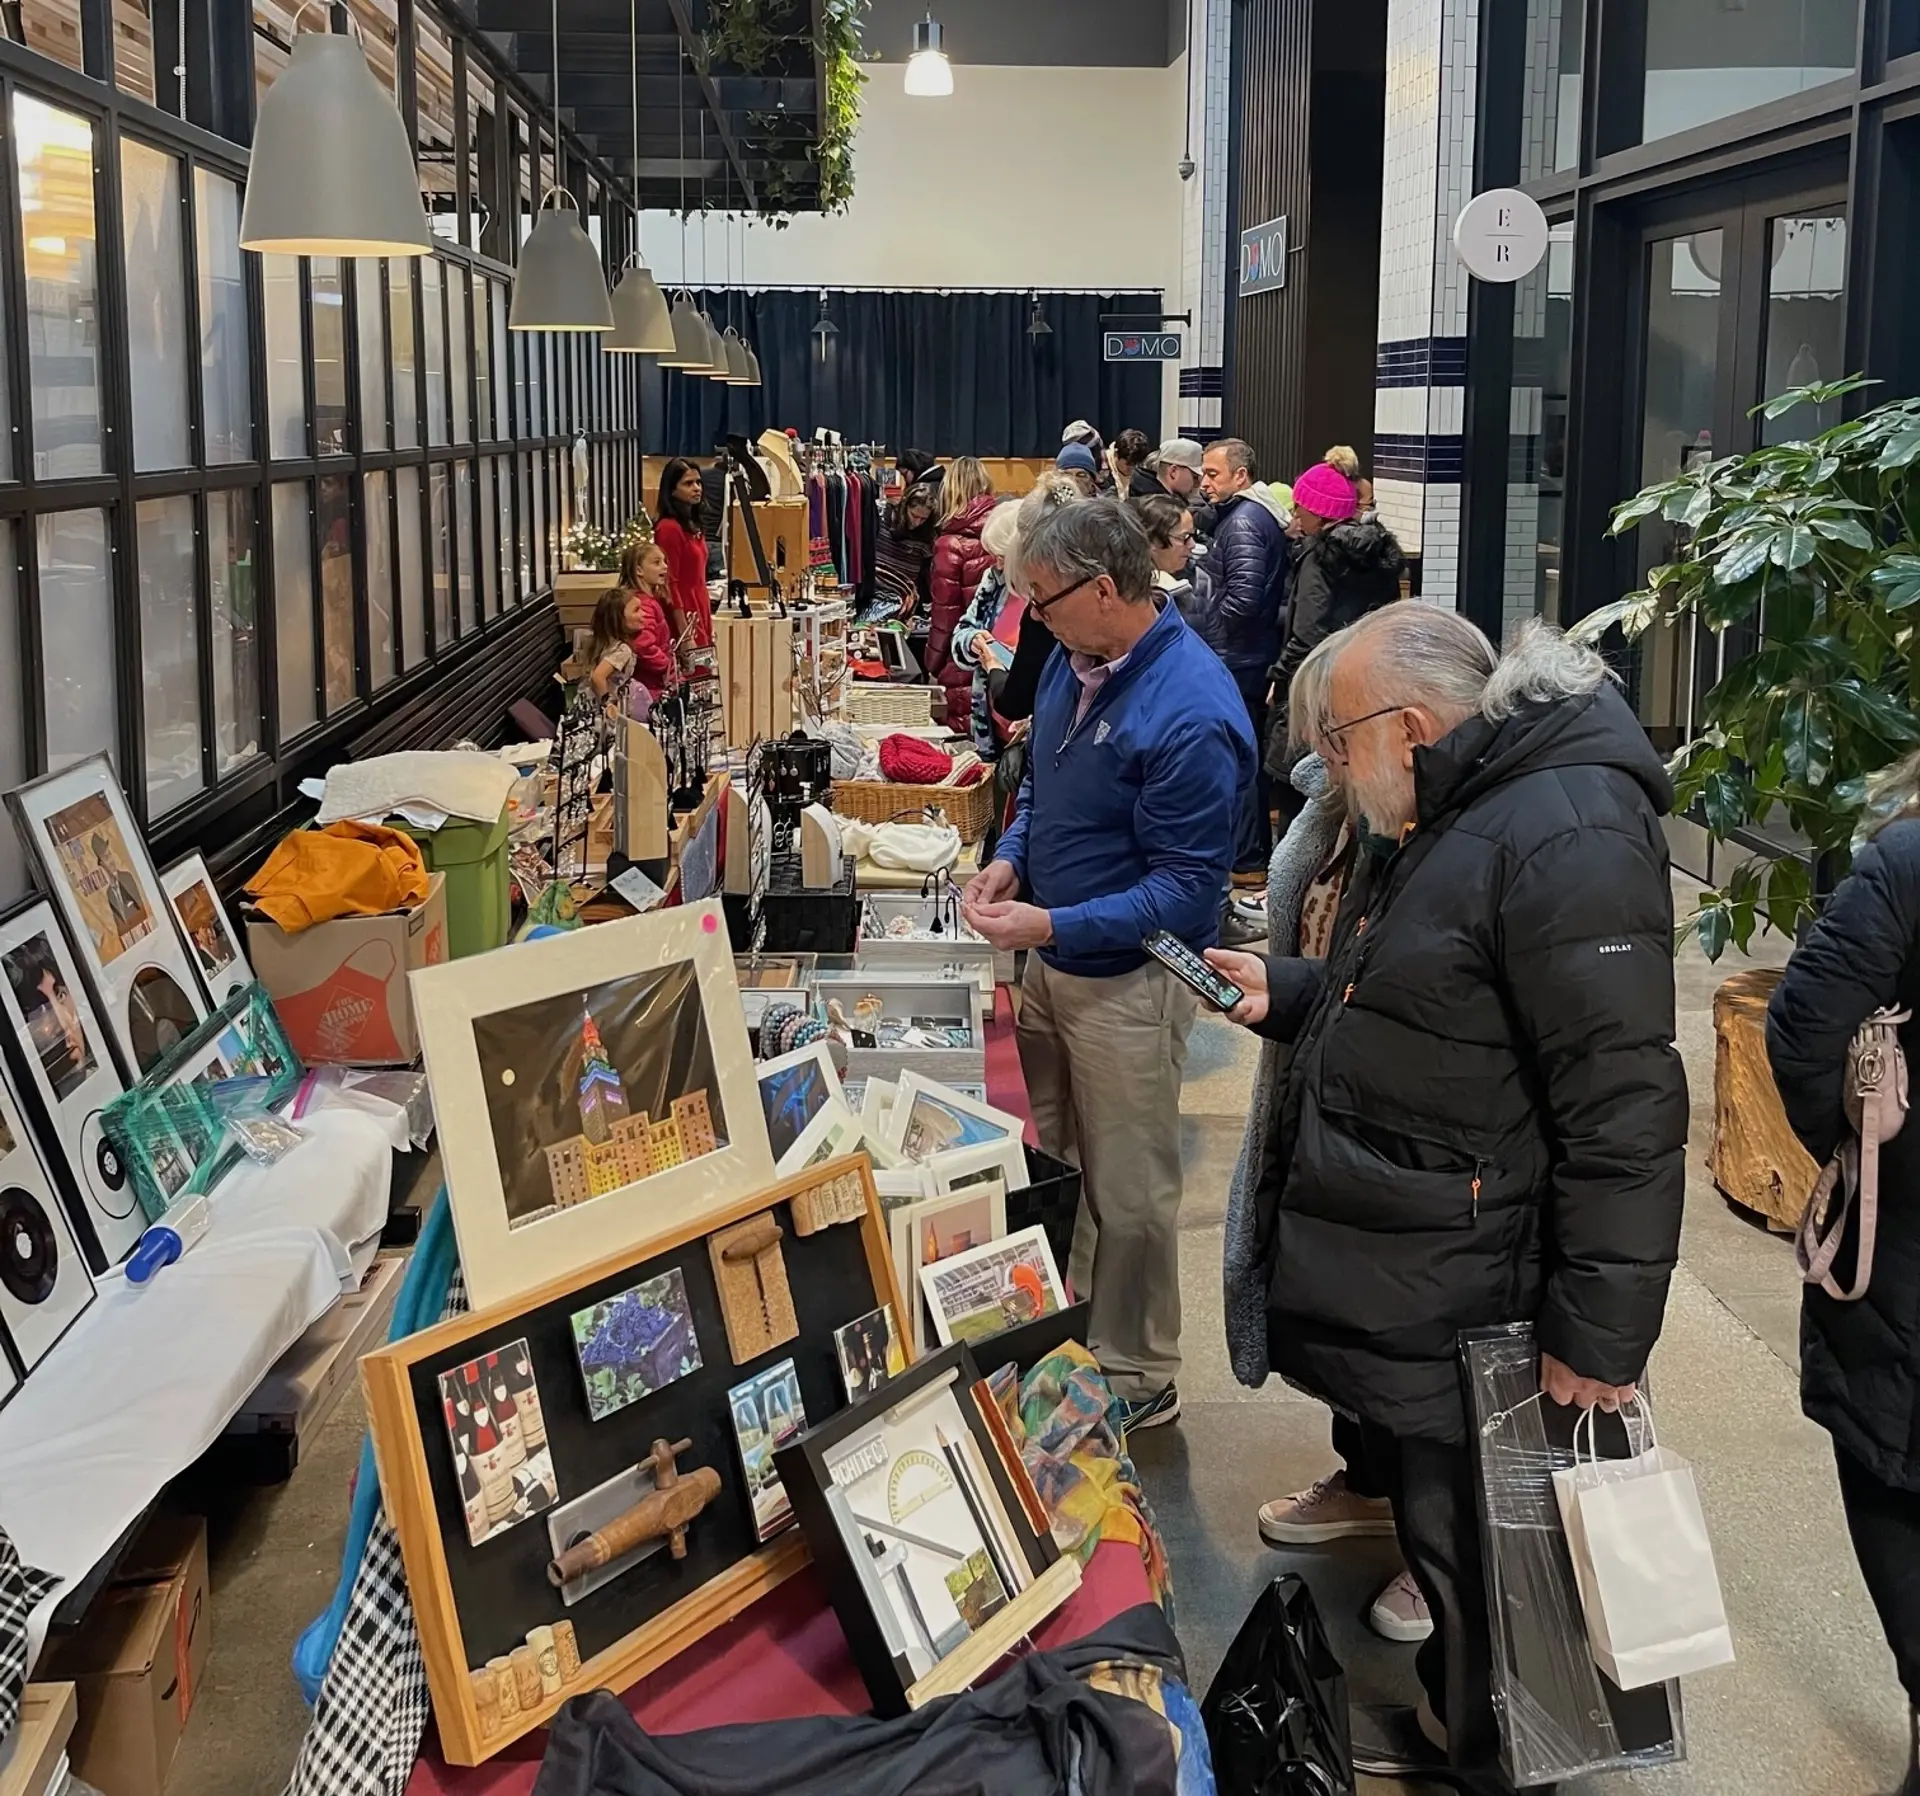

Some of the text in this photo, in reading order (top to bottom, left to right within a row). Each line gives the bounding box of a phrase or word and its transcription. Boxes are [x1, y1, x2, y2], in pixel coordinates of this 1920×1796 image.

[1498, 208, 1510, 227] E
[1497, 244, 1509, 262] R
[828, 1438, 889, 1488] RCHITECT
